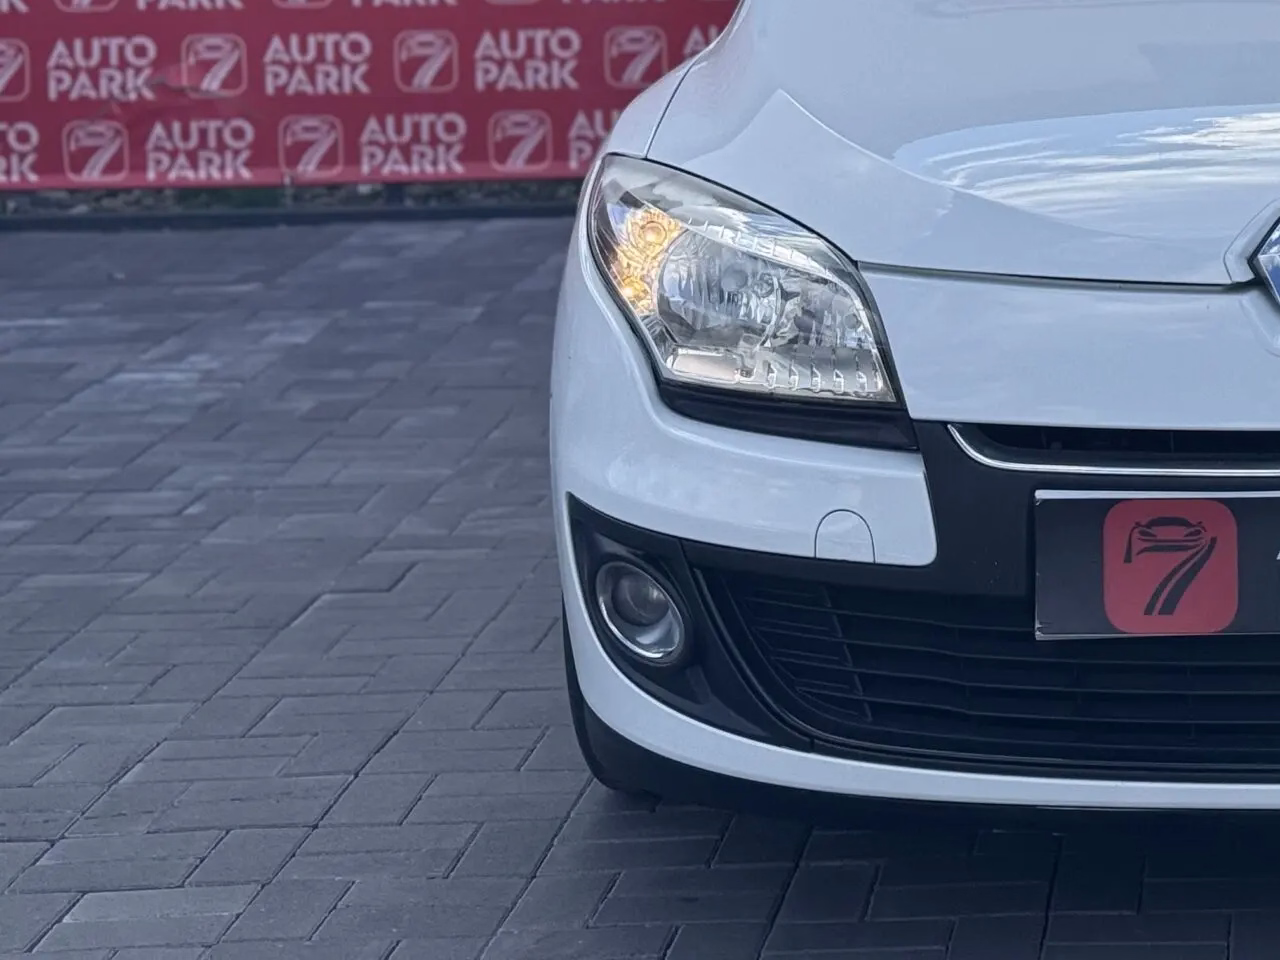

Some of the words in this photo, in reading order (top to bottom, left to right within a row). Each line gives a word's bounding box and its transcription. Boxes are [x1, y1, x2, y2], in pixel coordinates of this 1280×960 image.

[47, 35, 157, 69] AUTO
[263, 32, 372, 63] AUTO
[474, 28, 581, 59] AUTO
[48, 66, 155, 101] PARK
[265, 64, 369, 95] PARK
[475, 60, 578, 91] PARK
[146, 118, 254, 150] AUTO
[360, 113, 466, 143] AUTO
[146, 151, 250, 182] PARK
[361, 144, 465, 175] PARK
